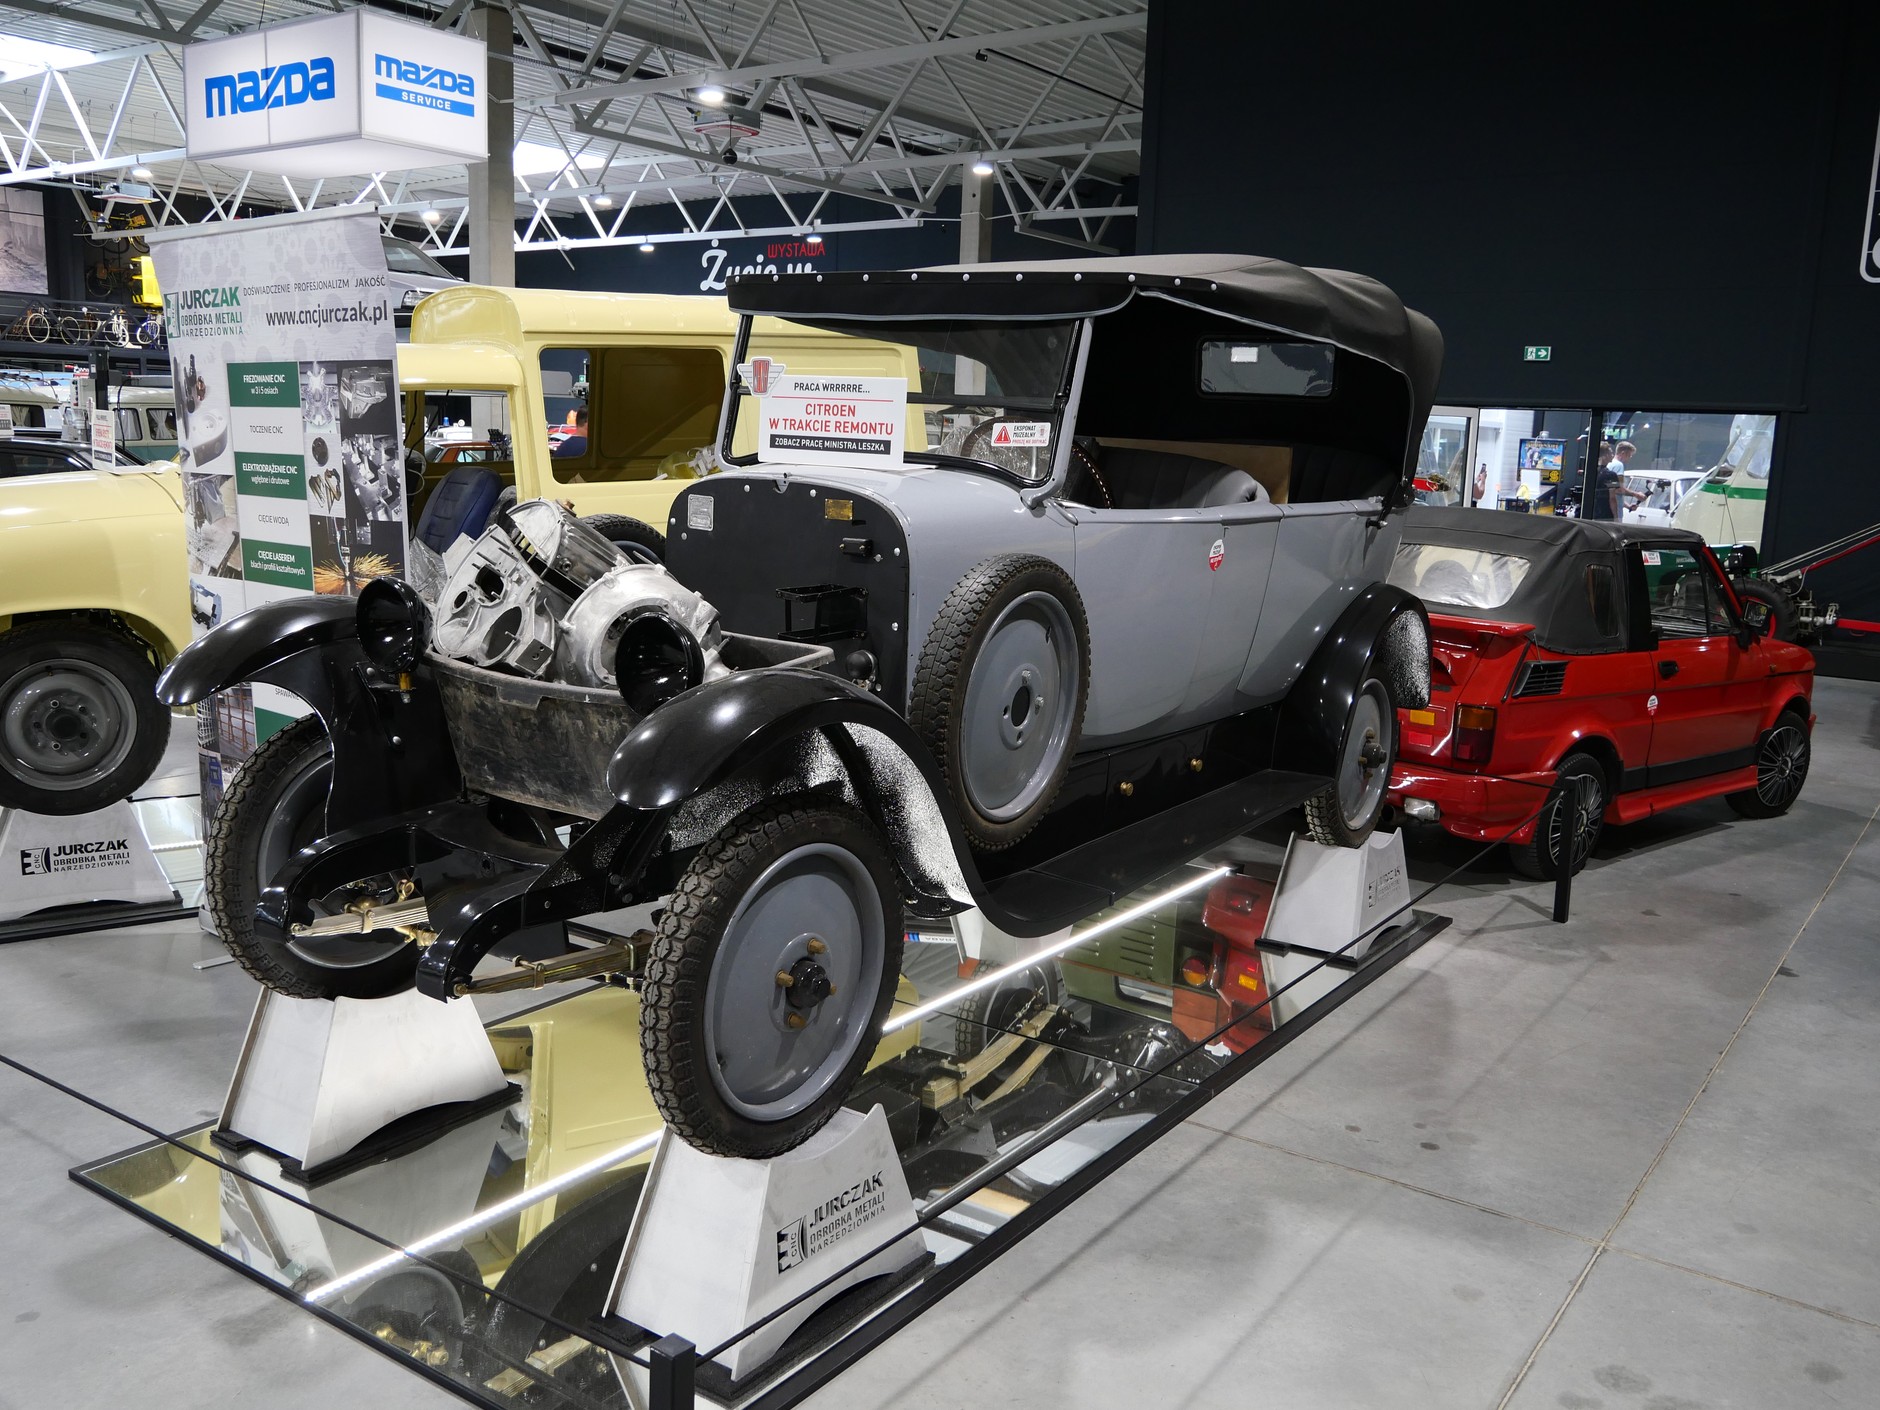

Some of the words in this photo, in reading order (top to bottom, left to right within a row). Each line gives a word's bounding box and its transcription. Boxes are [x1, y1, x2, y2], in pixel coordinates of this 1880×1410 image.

[401, 91, 451, 110] SERVICE
[767, 242, 826, 258] WYSTAWA
[243, 283, 291, 297] DOŚWIADCZENIE
[294, 278, 350, 293] PROFESJONALIZM
[354, 276, 387, 288] JAKOŚĆ
[180, 286, 241, 309] JURCZAK
[181, 312, 213, 326] OBRÓBKA
[215, 311, 242, 325] METALI
[266, 300, 388, 328] www.cncjurczak.pl
[243, 374, 273, 384] FREZOWANIE
[273, 374, 286, 383] CNC
[794, 382, 820, 392] PRACA
[822, 383, 870, 394] WRRRRRE...
[805, 403, 856, 417] CITROEN
[249, 425, 272, 434] TOCZENIE
[272, 426, 283, 434] CNC
[769, 417, 780, 430] W
[783, 418, 831, 433] TRAKCIE
[834, 421, 894, 436] REMONTU
[775, 437, 800, 447] ZOBACZ
[824, 440, 857, 450] MINISTRA
[858, 442, 885, 451] LESZKA
[286, 465, 298, 474] CNC
[258, 514, 273, 524] CIĘCIE
[273, 552, 295, 563] LASEREM
[53, 839, 129, 857] JURCZAK
[53, 855, 96, 866] OBROBKA
[99, 852, 130, 862] METALI
[54, 859, 130, 873] NARZEDZIOWNIA
[809, 1170, 884, 1228] JURCZAK
[810, 1211, 852, 1245] OBROBKA
[855, 1191, 885, 1218] METALI
[810, 1204, 886, 1256] NARZEDZIOWNIA
